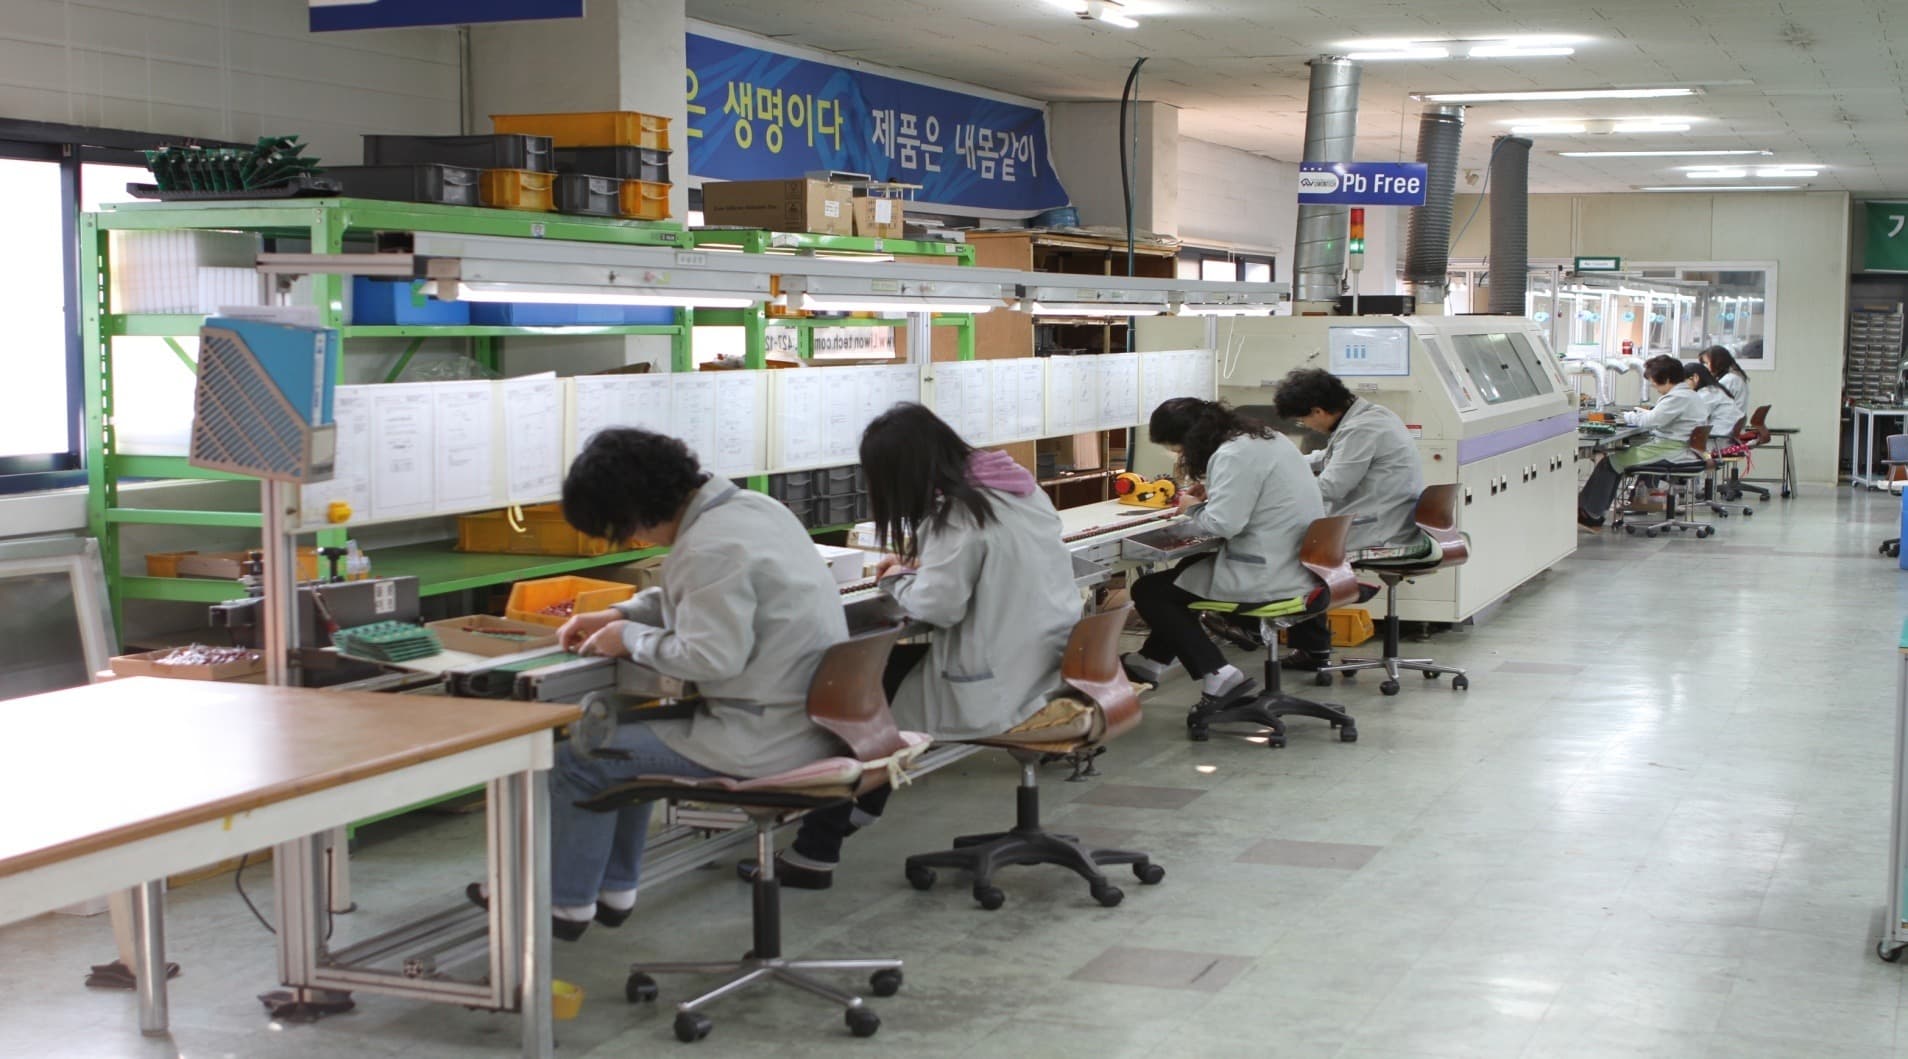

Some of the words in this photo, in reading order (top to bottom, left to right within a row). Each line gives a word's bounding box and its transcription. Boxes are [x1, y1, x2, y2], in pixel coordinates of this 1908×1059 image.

[723, 80, 844, 155] 생명이다
[872, 108, 943, 173] 제품은
[955, 123, 1037, 182] 내몸같이
[1342, 173, 1367, 193] Pb
[1374, 173, 1420, 194] Free
